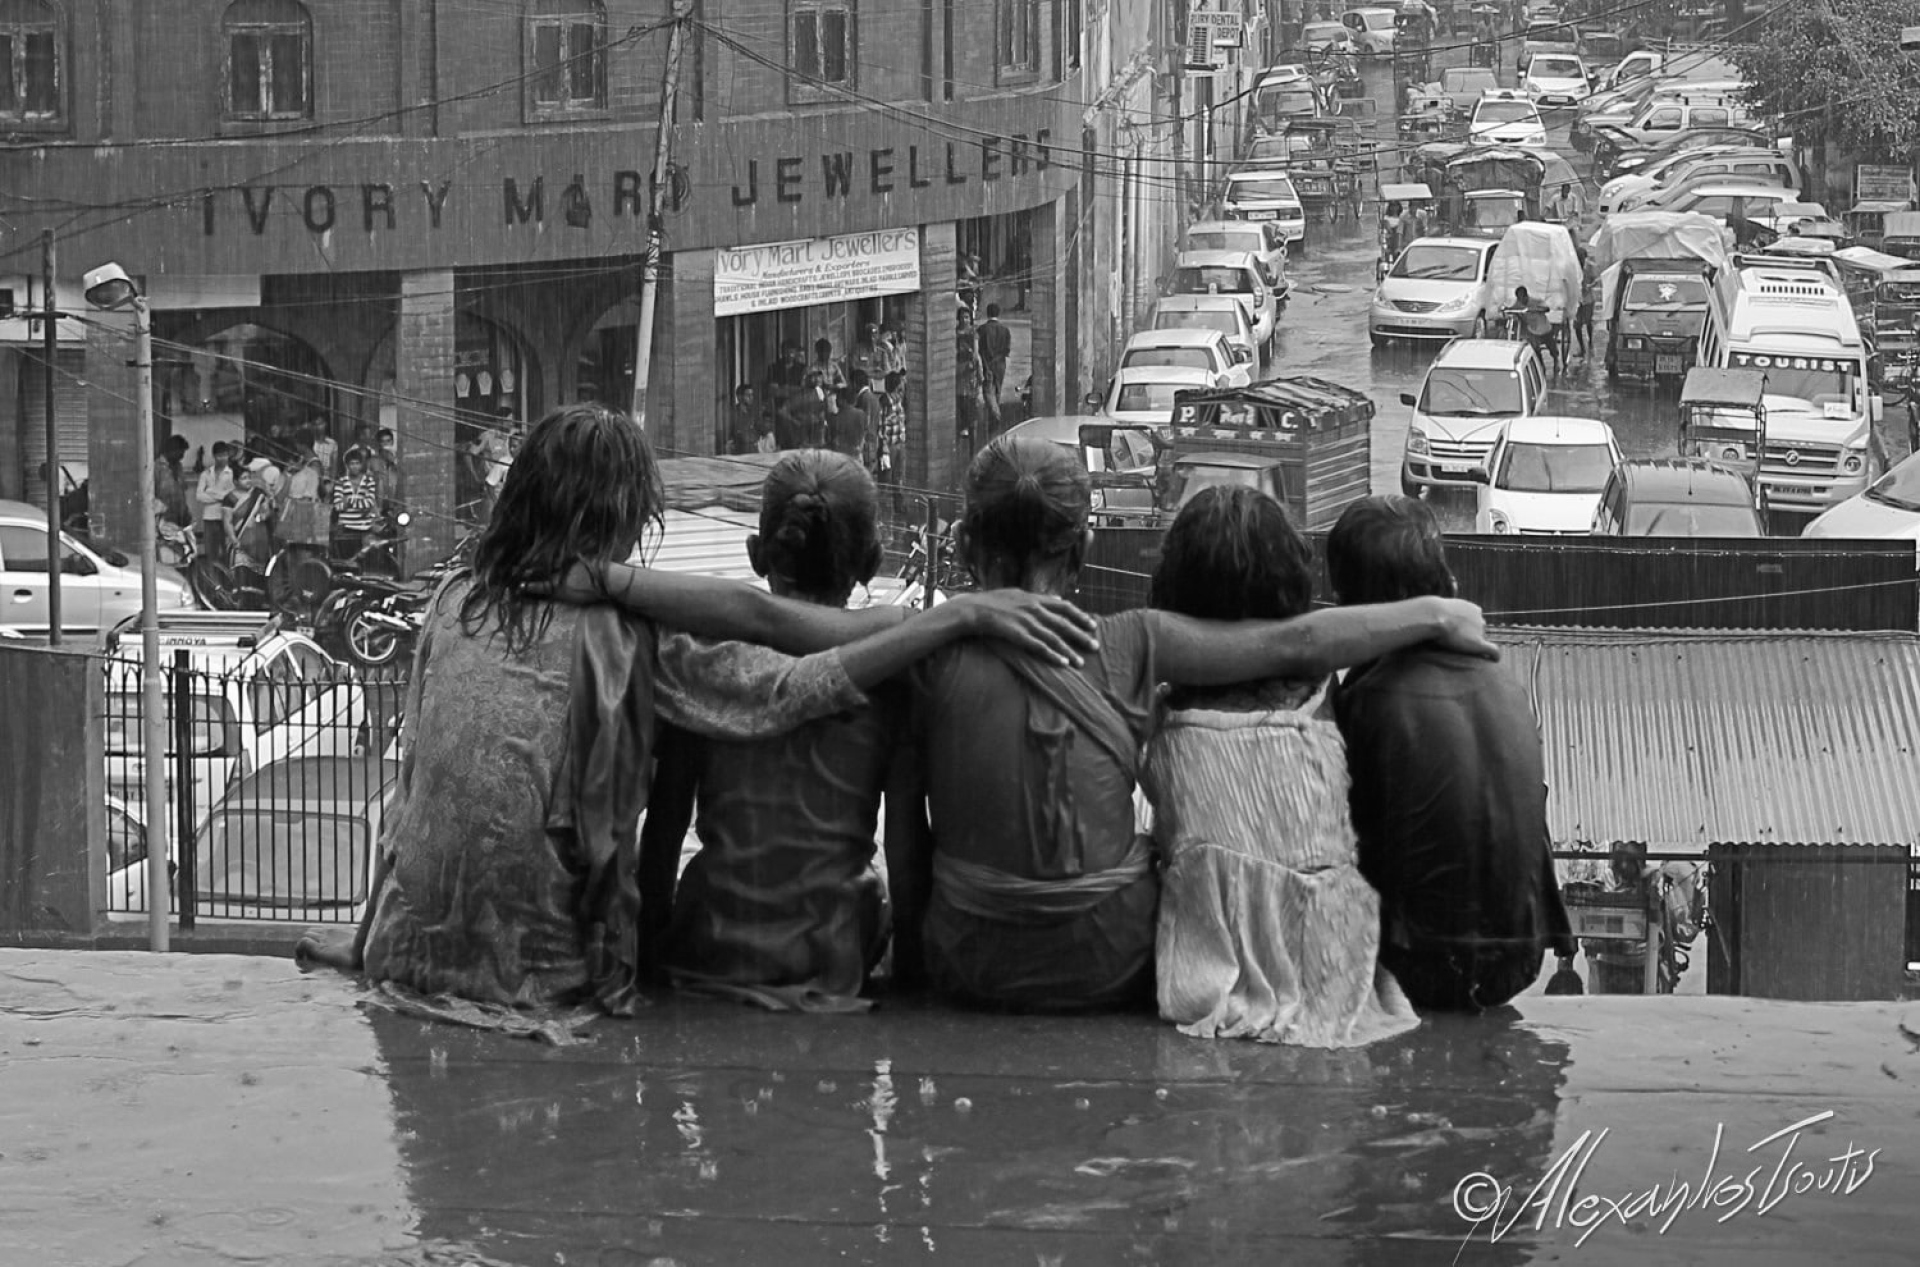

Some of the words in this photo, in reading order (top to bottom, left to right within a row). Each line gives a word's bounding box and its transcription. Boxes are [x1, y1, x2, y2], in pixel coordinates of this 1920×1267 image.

[1211, 13, 1240, 25] DENTAL
[1216, 27, 1239, 38] DEPOT
[204, 179, 451, 236] IVORY
[731, 127, 1050, 207] JEWELLERS
[715, 249, 763, 278] Ivory
[766, 241, 815, 268] Mart
[821, 230, 916, 261] Jewellers
[1737, 354, 1850, 372] TOURIST
[1180, 406, 1195, 423] P.
[1282, 412, 1299, 429] C.
